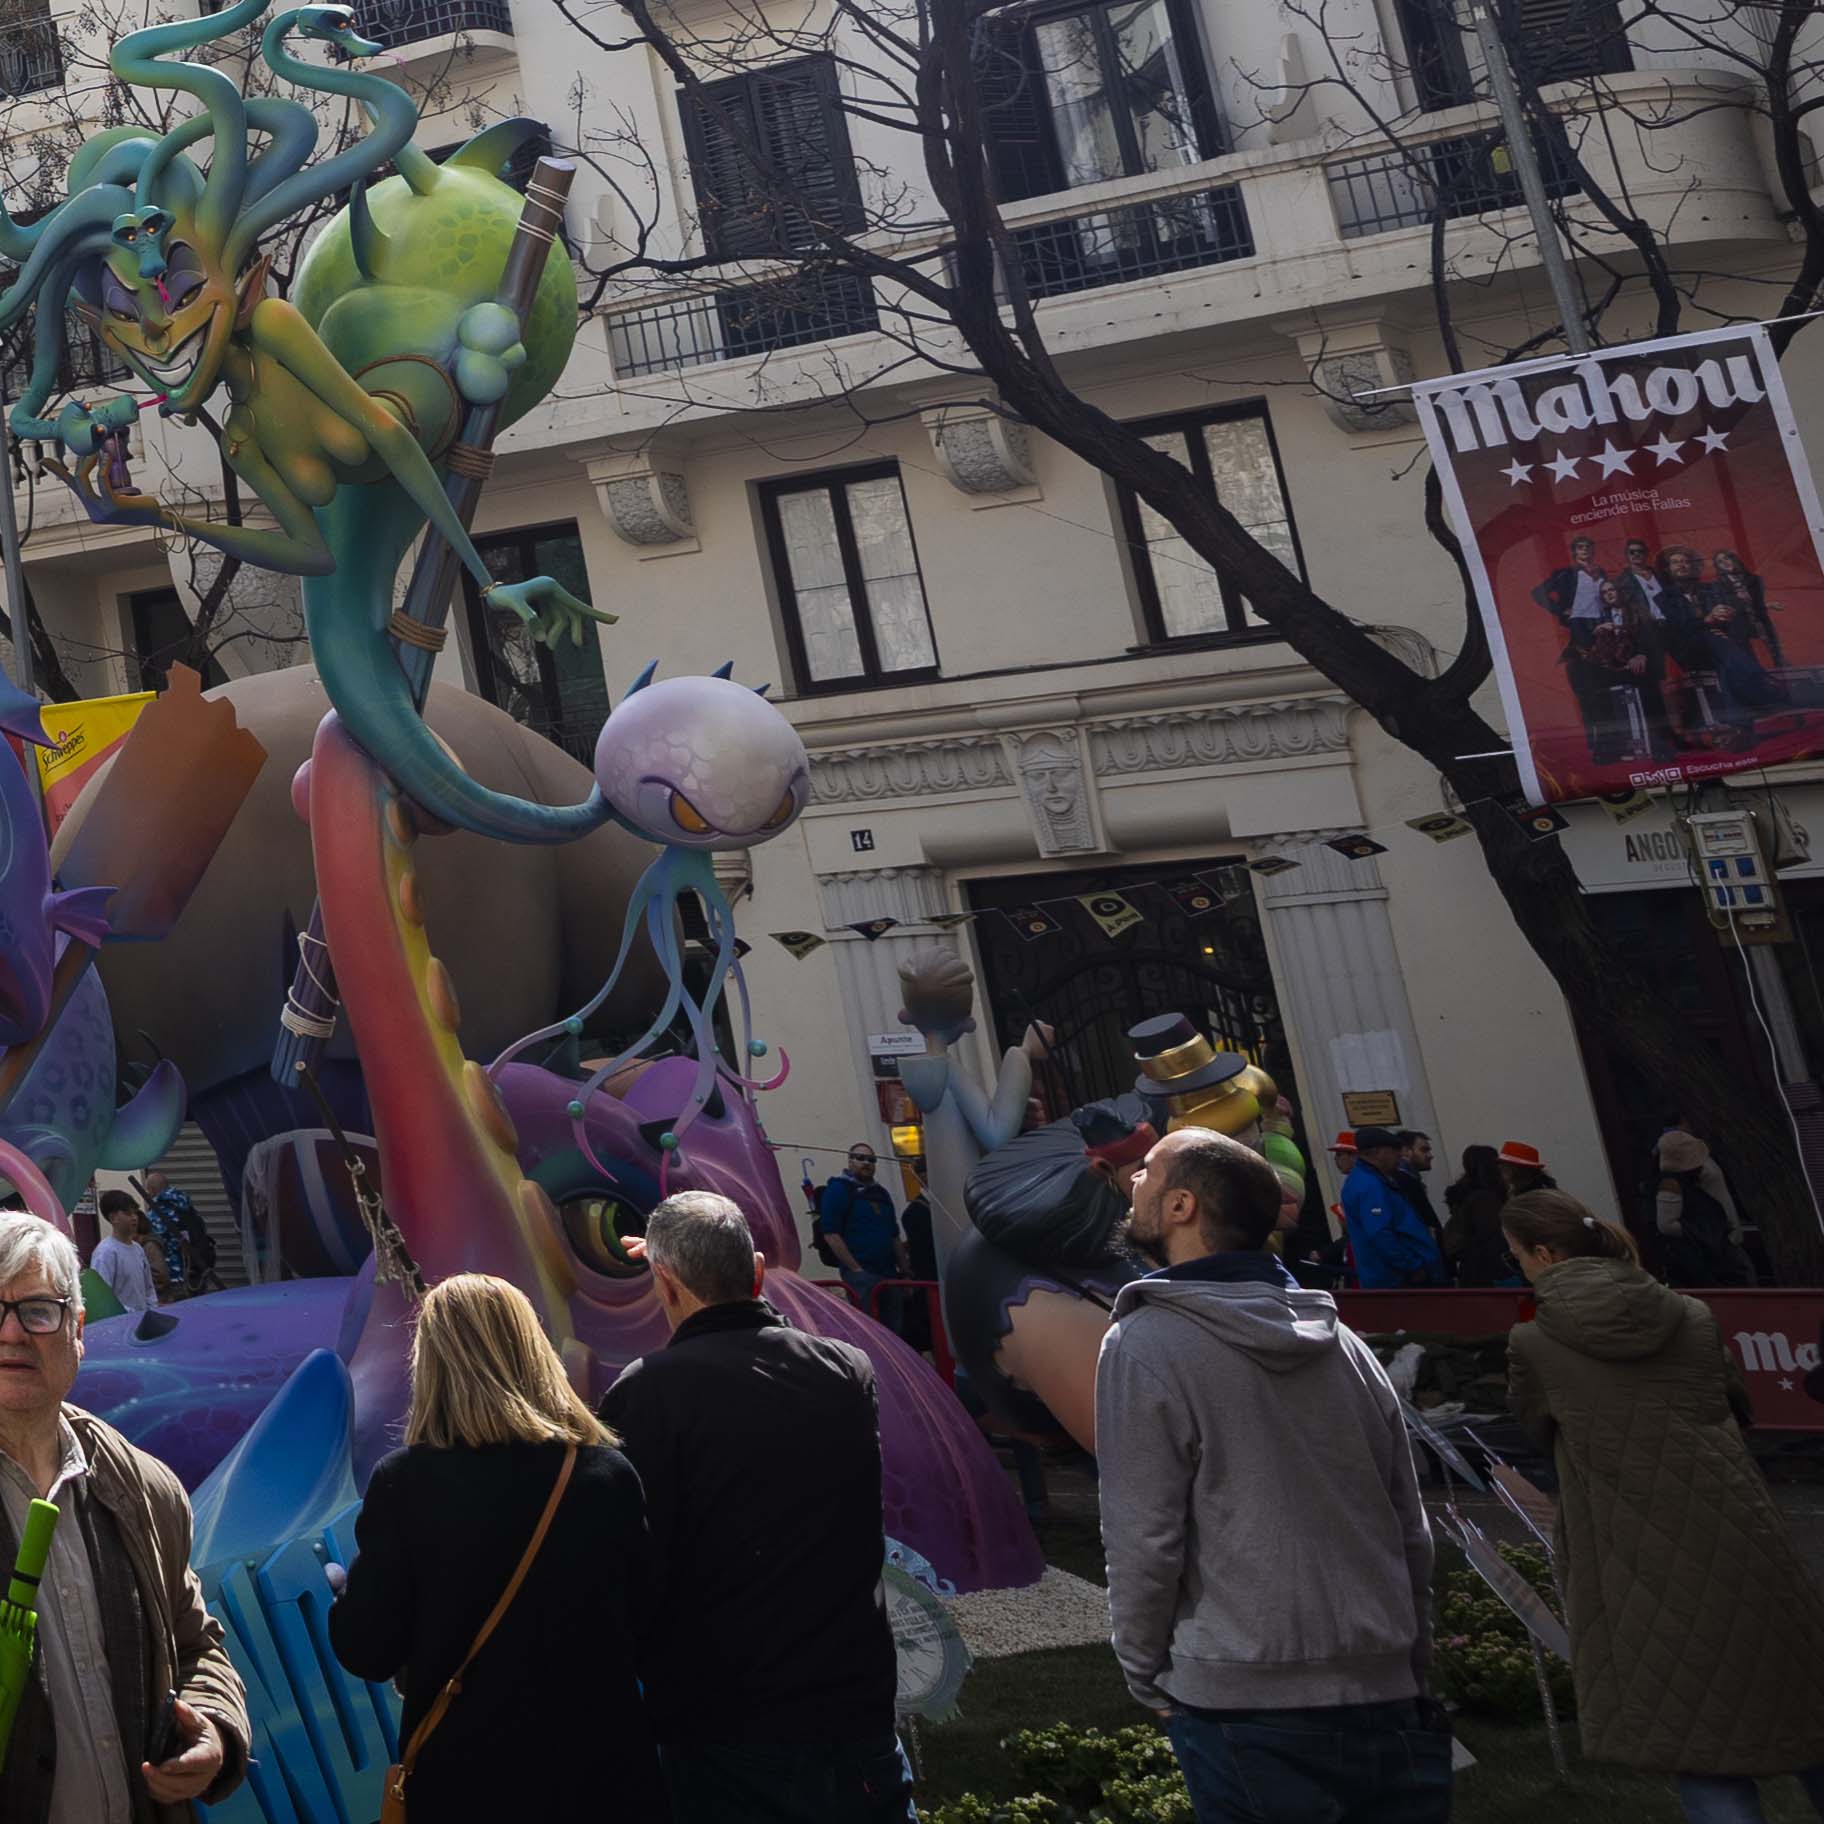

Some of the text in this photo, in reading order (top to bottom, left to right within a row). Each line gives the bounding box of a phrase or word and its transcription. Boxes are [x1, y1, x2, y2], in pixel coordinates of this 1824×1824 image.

[1570, 497, 1691, 524] enciende las Fallas
[854, 832, 871, 849] 14
[1625, 831, 1688, 862] ANGO
